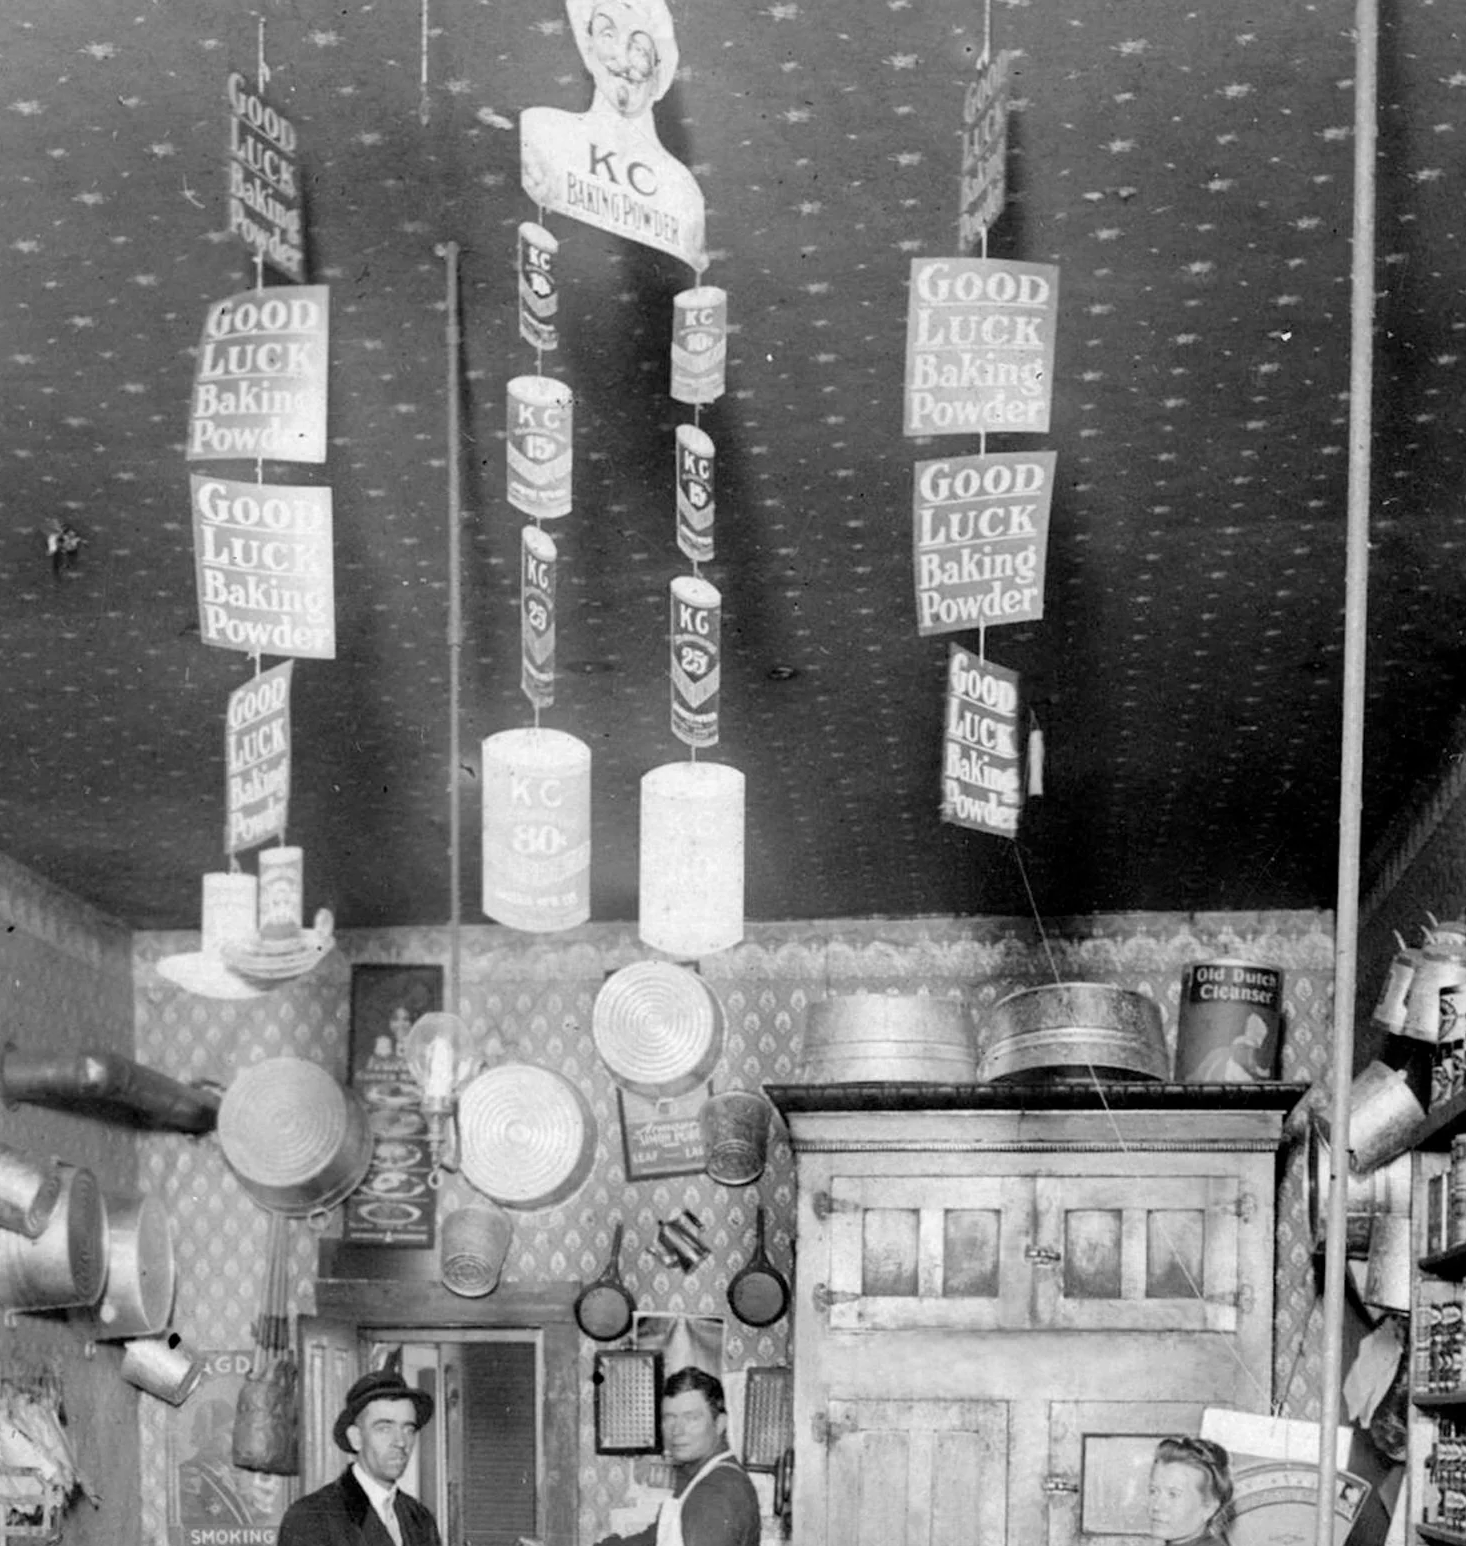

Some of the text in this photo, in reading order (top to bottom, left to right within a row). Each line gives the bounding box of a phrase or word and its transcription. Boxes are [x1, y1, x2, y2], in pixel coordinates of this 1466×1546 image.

[227, 72, 296, 152] GOOD
[233, 117, 295, 198] LUCK
[232, 160, 301, 245] Baking
[567, 171, 680, 247] BAKING POWDER
[231, 198, 303, 272] Powder
[916, 264, 1050, 304] GOOD
[208, 302, 319, 337] GOOD
[686, 308, 714, 327] KC
[915, 308, 1044, 347] LUCK
[202, 342, 313, 375] LUCK
[913, 351, 1044, 395] Baking
[518, 403, 561, 430] KC
[911, 388, 1044, 429] Powder
[193, 418, 313, 453] Powd
[685, 451, 710, 479] KC
[921, 463, 1044, 502] GOOD
[199, 483, 325, 530] GOOD
[920, 504, 1037, 547] LUCK
[201, 524, 323, 571] LUCK
[921, 545, 1036, 589] Baking
[528, 555, 549, 588] KC
[204, 569, 326, 624] Baking
[921, 581, 1037, 628] Powder
[206, 604, 331, 651] Powder
[680, 603, 709, 635] KC
[232, 678, 287, 730] GOOD
[951, 653, 1016, 712] GOOD
[232, 718, 287, 767] LUCK
[950, 698, 1017, 755] LUCK
[511, 778, 562, 808] KC
[946, 742, 1018, 804] Baking
[943, 780, 1018, 830] Powder
[1197, 967, 1276, 986] Old Dutch
[1200, 983, 1272, 1003] Cleanser
[191, 1529, 275, 1545] SMOKING
